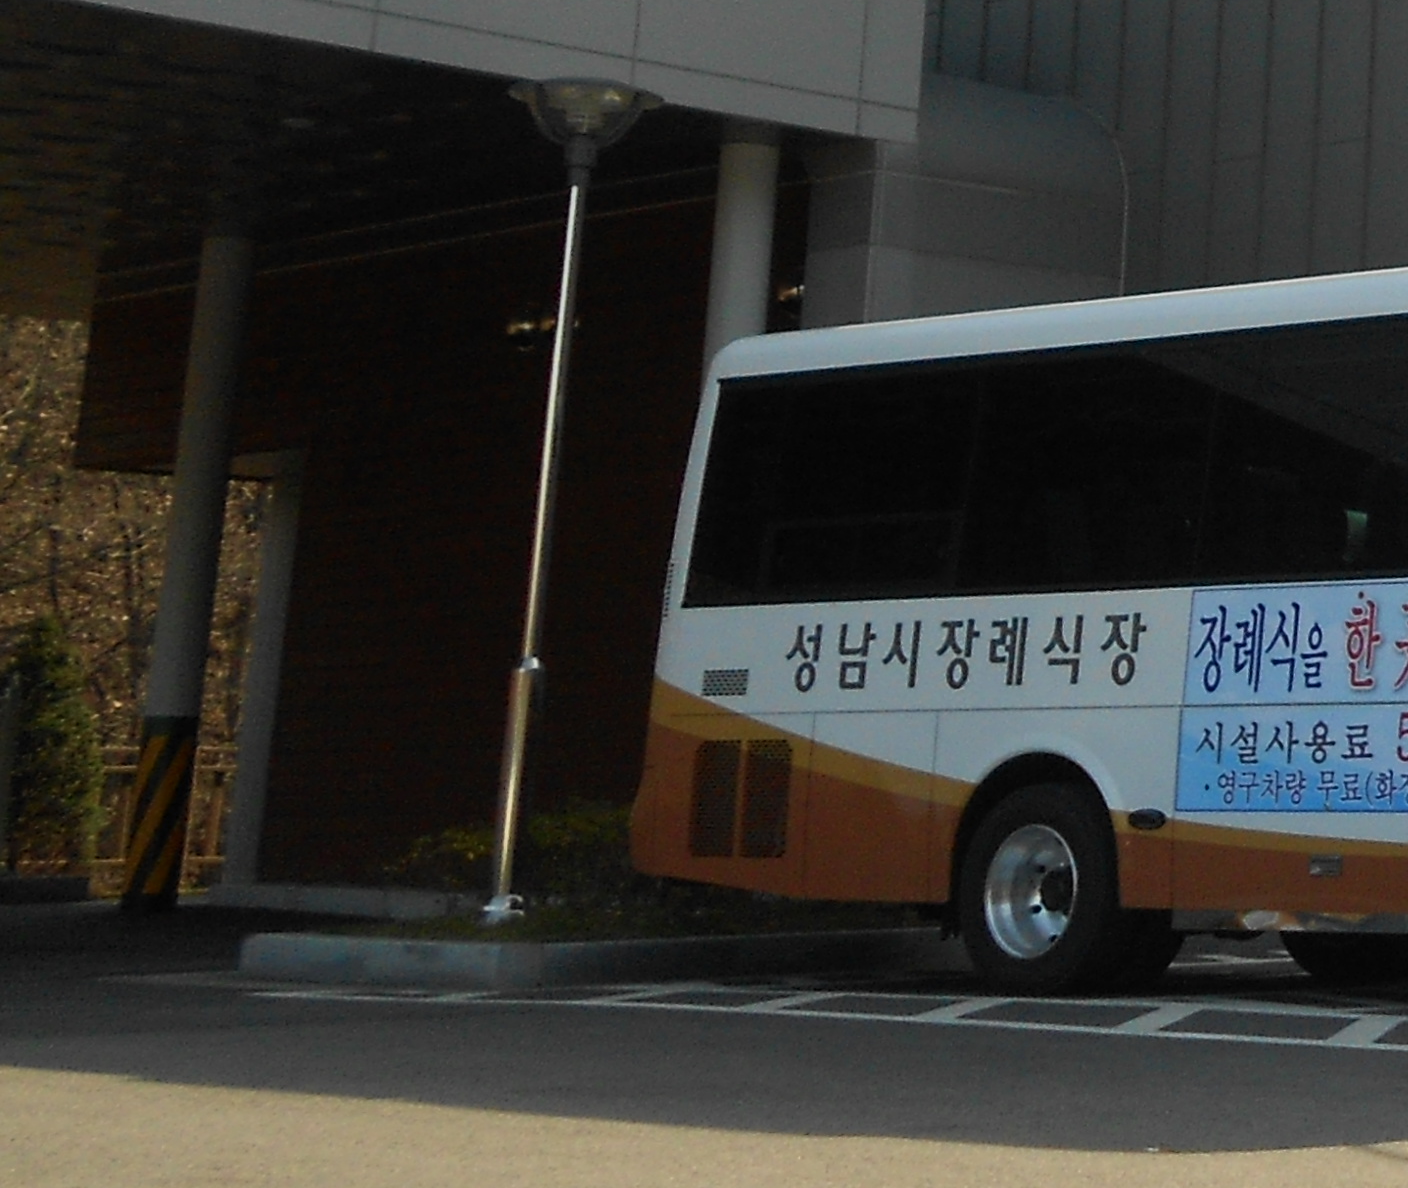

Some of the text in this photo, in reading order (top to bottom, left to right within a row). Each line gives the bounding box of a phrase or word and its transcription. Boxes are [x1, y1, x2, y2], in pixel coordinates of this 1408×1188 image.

[786, 612, 1147, 693] 성남시장례식장
[1195, 601, 1327, 693] 장례식을
[1345, 589, 1381, 689] 한
[1195, 720, 1375, 764] 시설사용료
